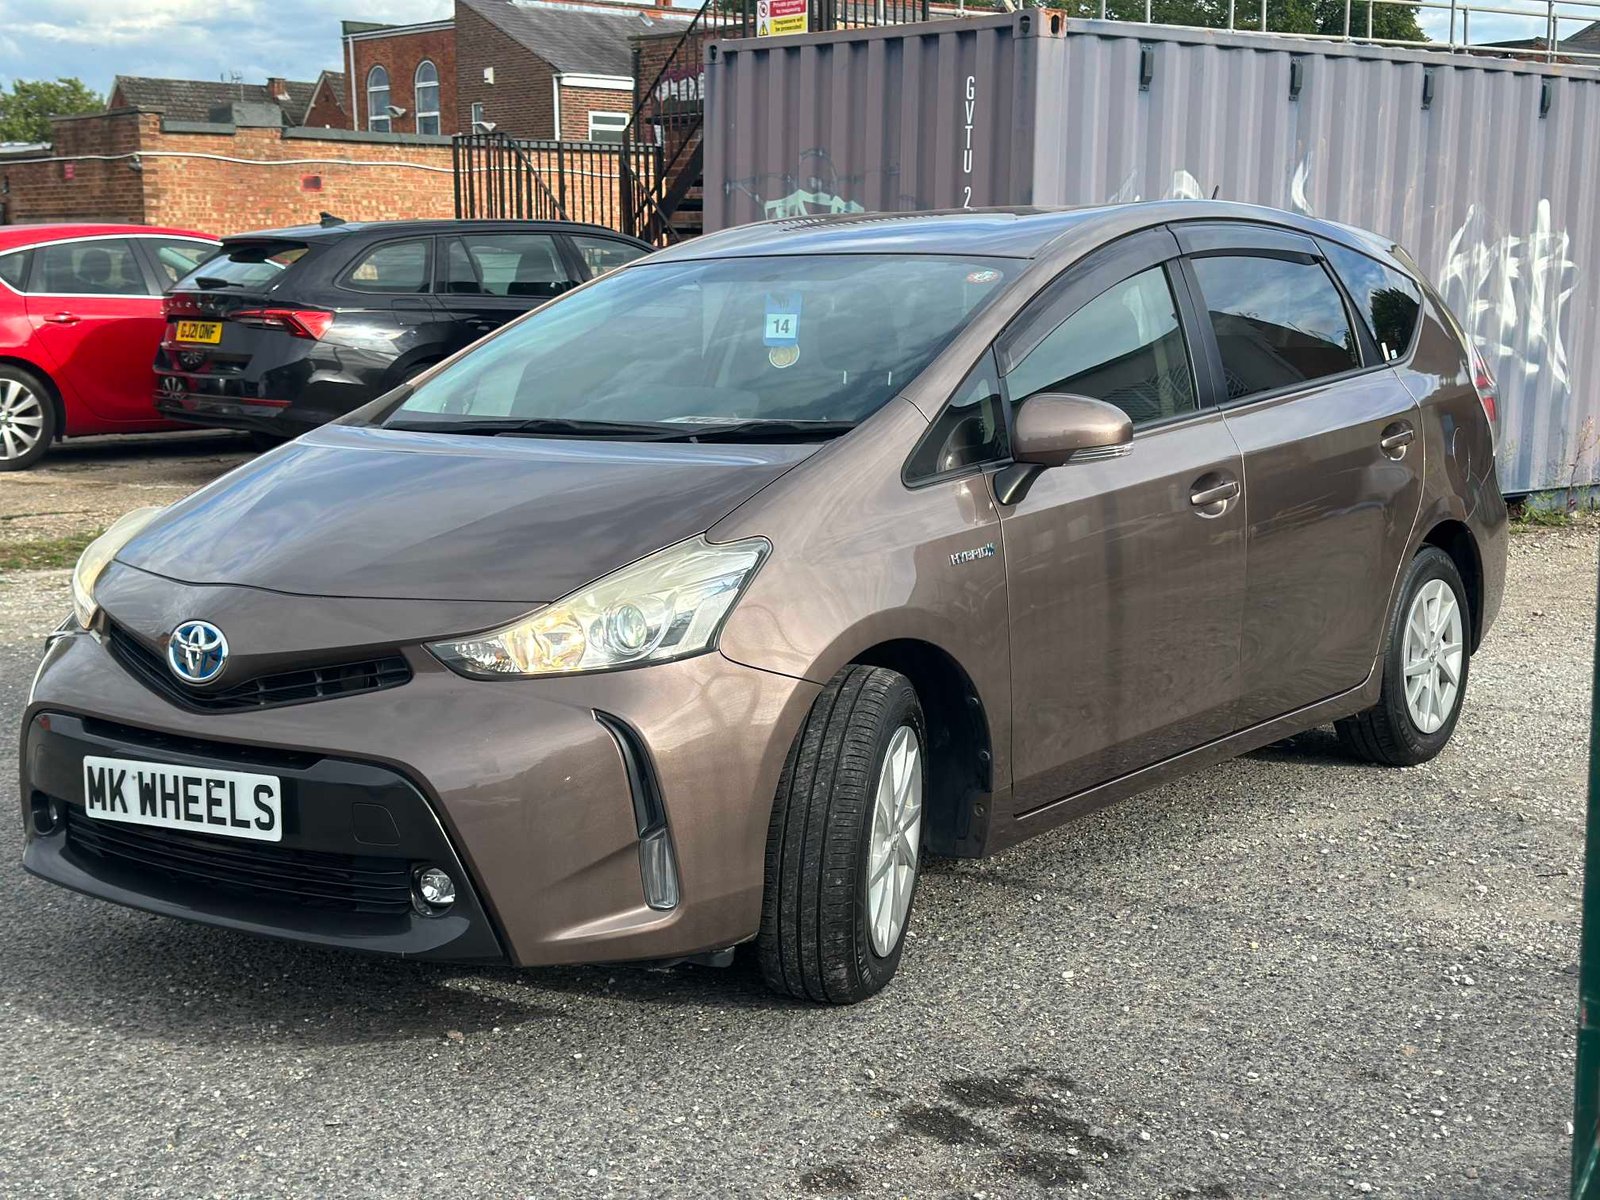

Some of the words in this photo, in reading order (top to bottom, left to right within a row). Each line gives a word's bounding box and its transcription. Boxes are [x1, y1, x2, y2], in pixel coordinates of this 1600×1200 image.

[963, 76, 975, 173] GVTU
[964, 186, 972, 208] 2
[773, 318, 790, 334] 14
[949, 546, 989, 565] HYBRID
[87, 766, 128, 813] MK
[137, 771, 275, 831] WHEELS
